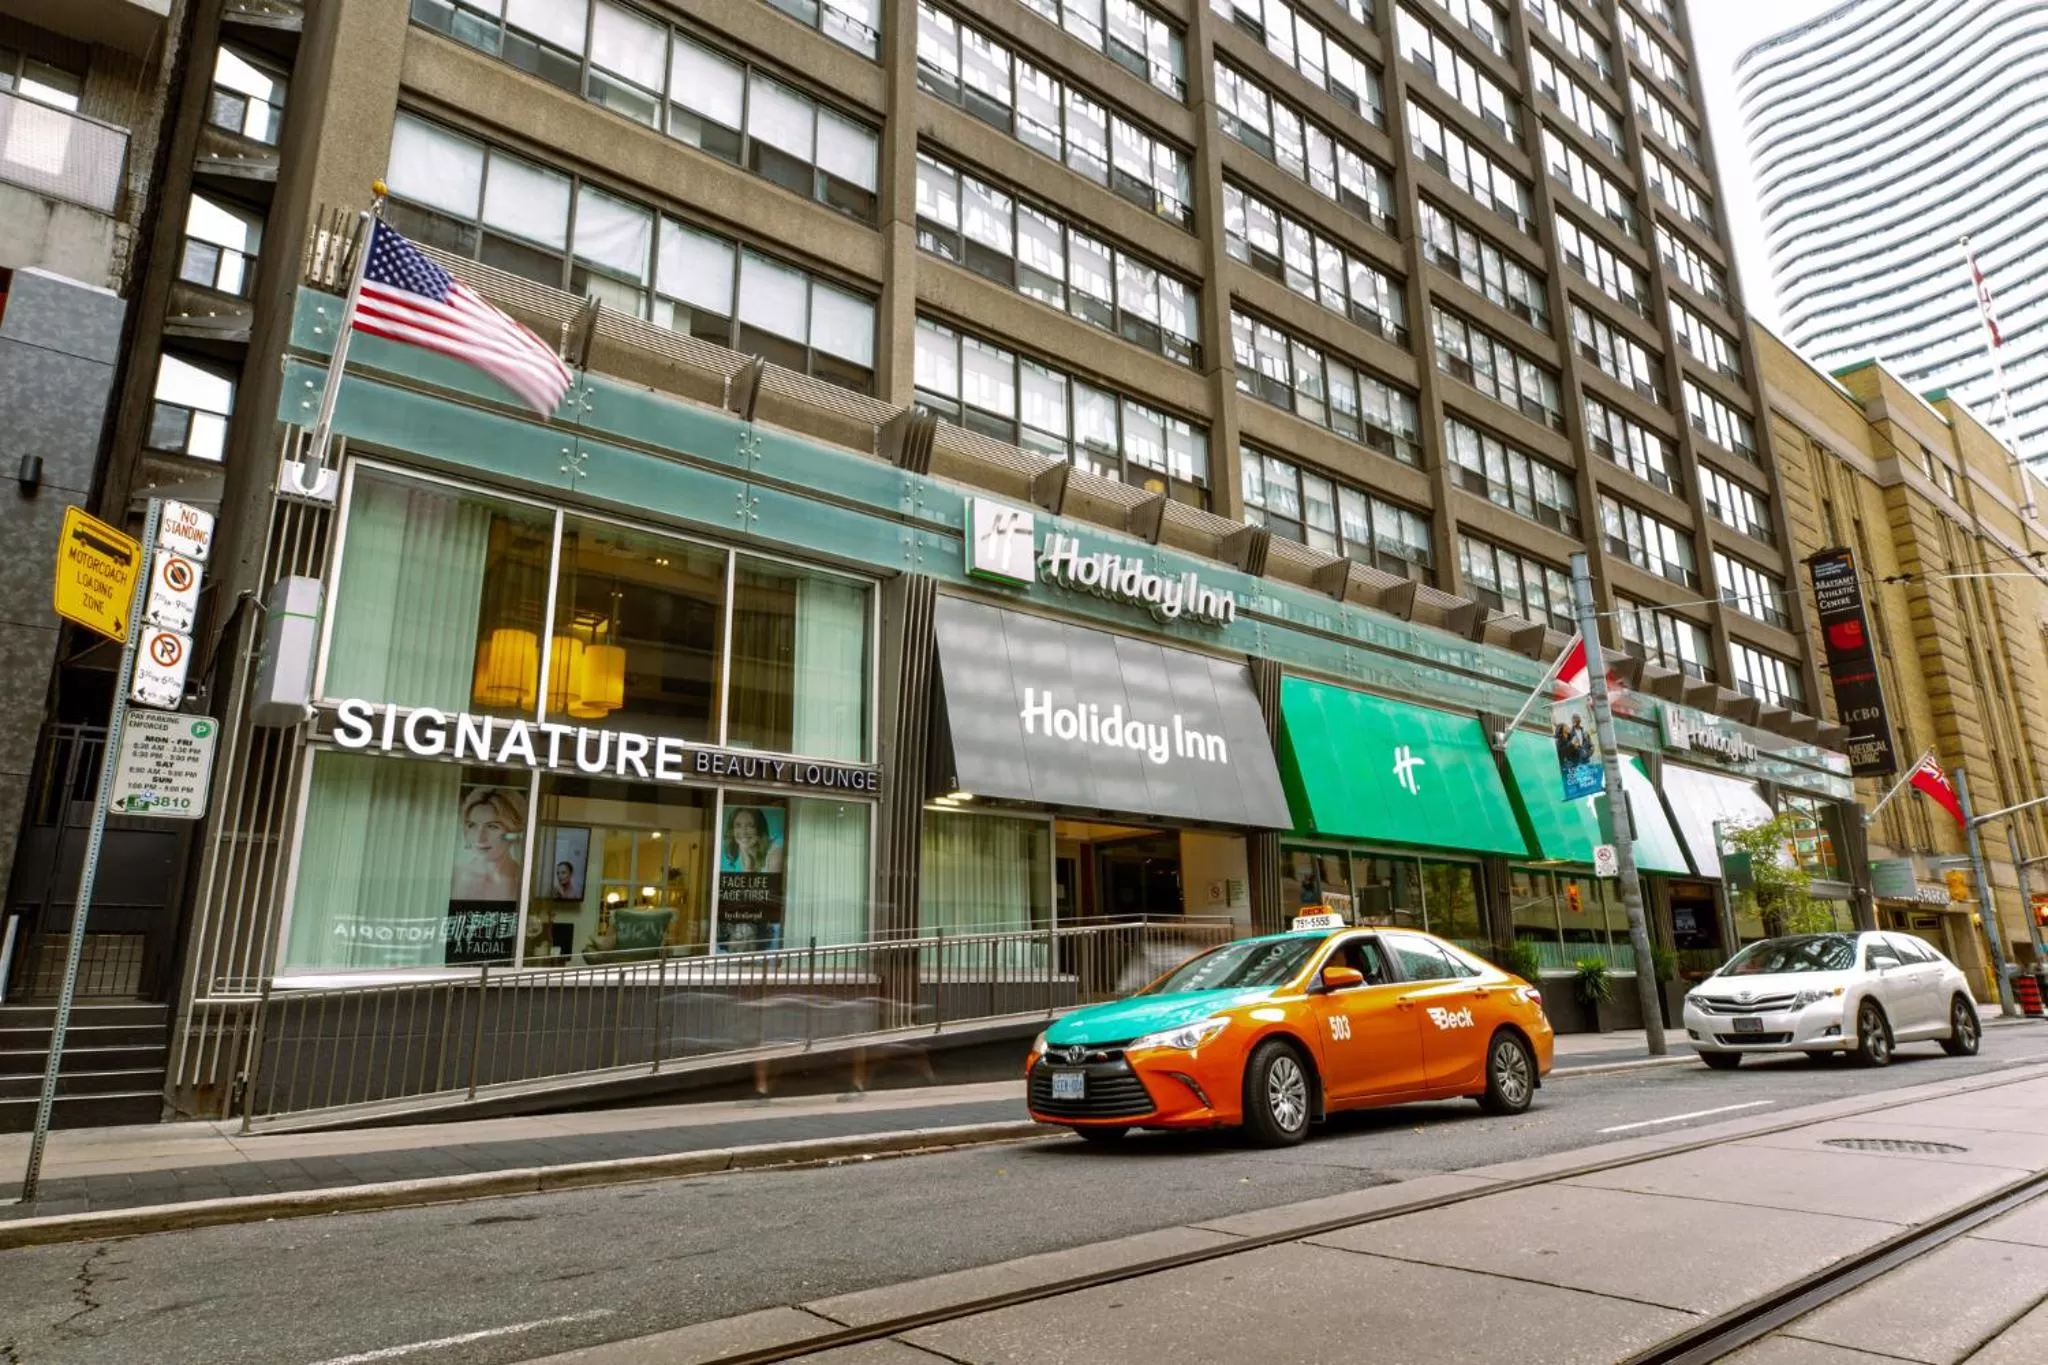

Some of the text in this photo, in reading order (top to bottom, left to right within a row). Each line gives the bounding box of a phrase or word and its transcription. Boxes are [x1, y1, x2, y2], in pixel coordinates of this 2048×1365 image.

[181, 509, 199, 526] NO
[165, 519, 208, 545] STANDING
[69, 546, 128, 585] MOTORCOACH
[76, 572, 113, 600] LOADING
[1038, 533, 1236, 624] Holiday Inn
[82, 593, 105, 615] ZONE
[146, 713, 179, 725] PARKING
[1844, 707, 1880, 722] LCBO
[1021, 688, 1228, 765] Holiday Inn
[145, 735, 169, 744] MON
[177, 738, 193, 746] FRI
[333, 698, 686, 782] SIGNATURE
[1849, 740, 1888, 754] MEDICAL
[1851, 751, 1880, 766] CLINIC
[696, 751, 877, 791] BEAUTY LOUNGE
[152, 776, 173, 784] SUN
[153, 796, 190, 808] 3810
[723, 876, 768, 888] FACE LIFE
[719, 889, 770, 902] FACE FIRST
[1296, 916, 1331, 929] 751-5555
[454, 940, 506, 954] A FACIAL
[1430, 1006, 1475, 1030] Beck
[1328, 1015, 1351, 1041] 503
